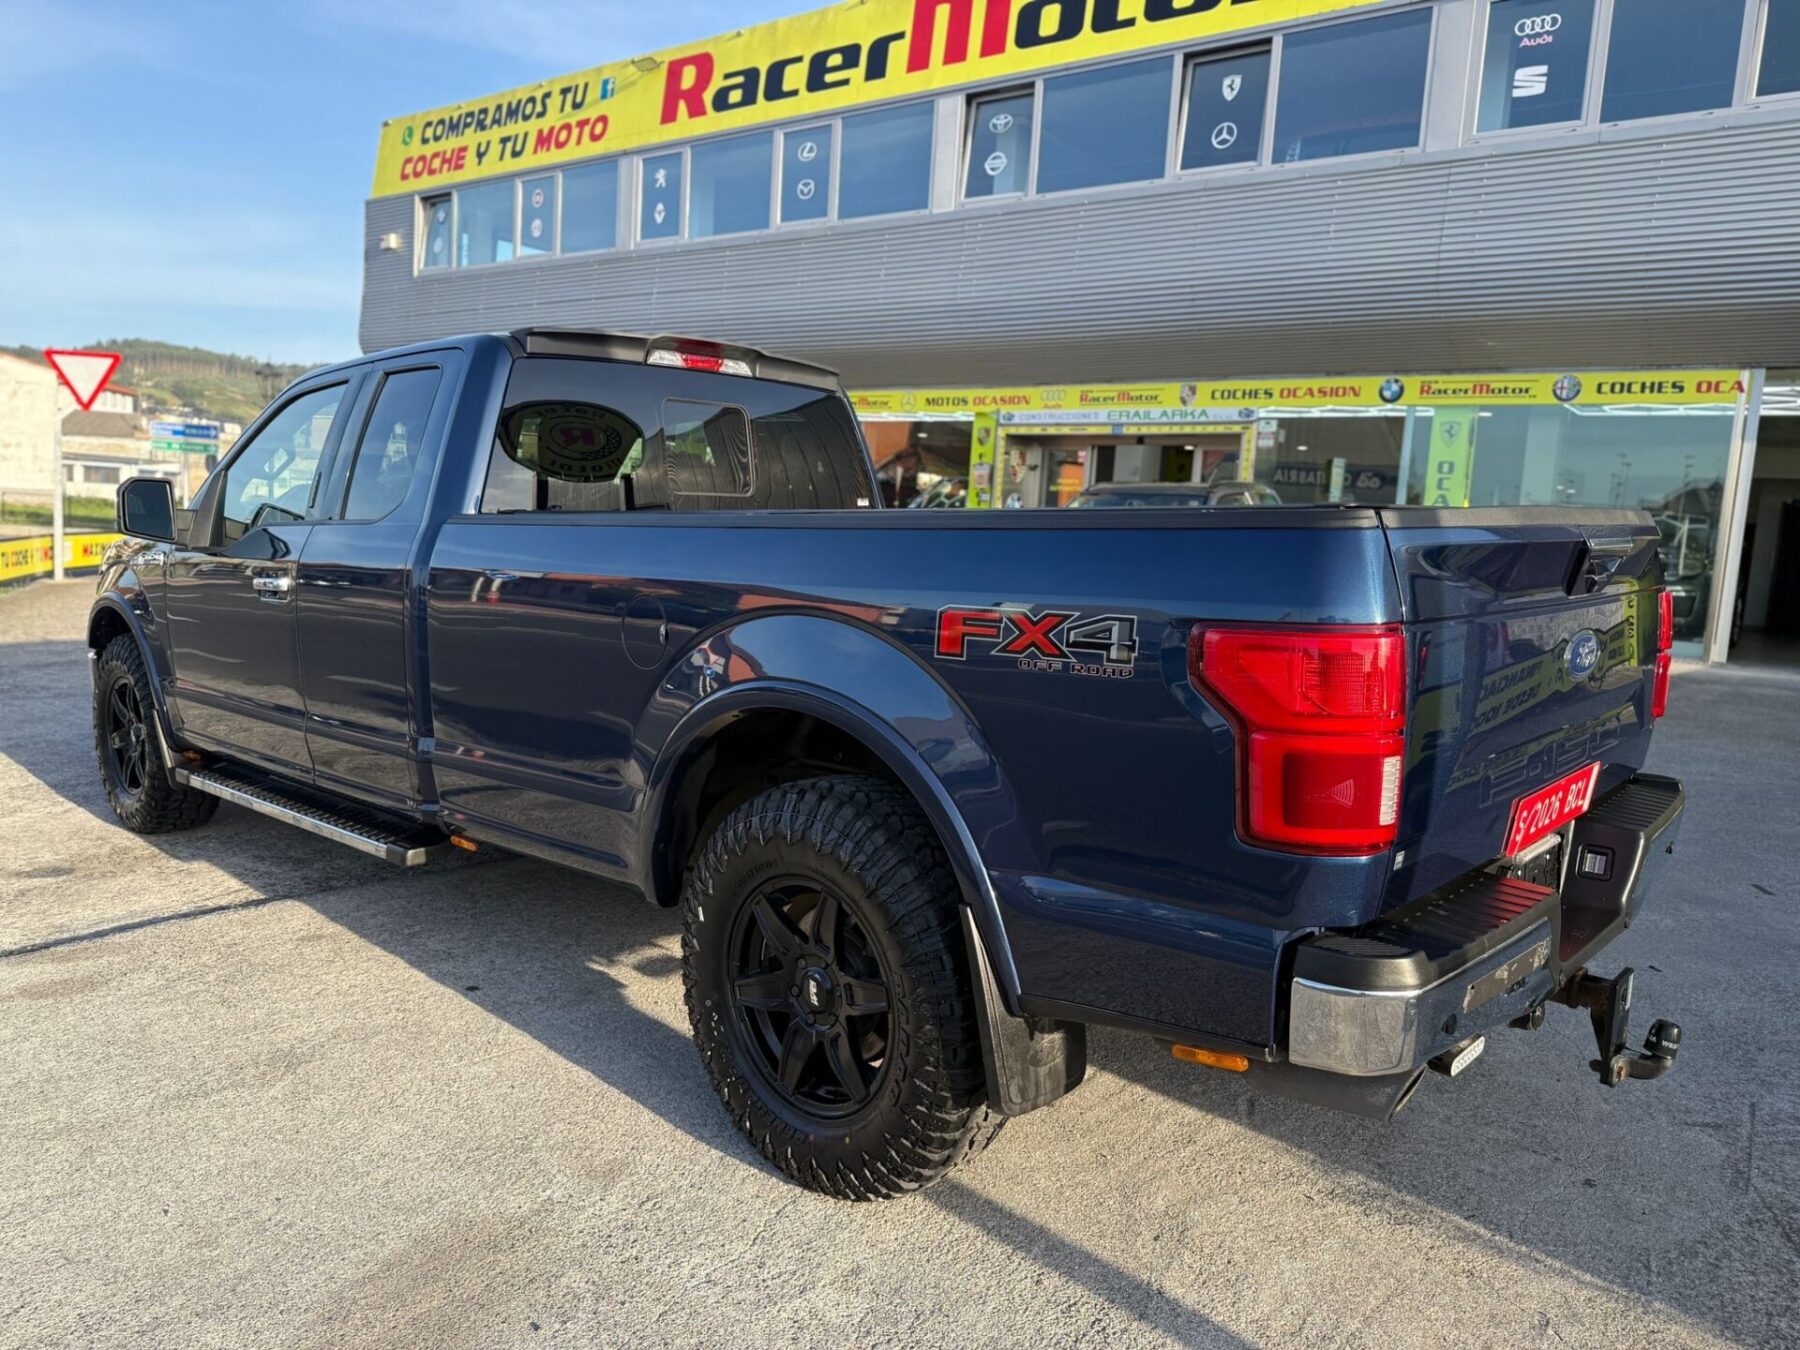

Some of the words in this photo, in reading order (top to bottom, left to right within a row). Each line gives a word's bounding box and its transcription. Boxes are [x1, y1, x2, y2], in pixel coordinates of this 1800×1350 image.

[1519, 34, 1553, 48] Audi
[659, 0, 1264, 126] RacerMot
[420, 91, 552, 145] COMPRAMOS
[559, 82, 589, 113] TU
[400, 145, 468, 181] COCHE
[475, 140, 491, 166] Y
[499, 131, 529, 162] TU
[532, 114, 609, 154] MOTO
[1211, 387, 1274, 400] COCHES
[1279, 385, 1362, 399] OCASION
[1418, 383, 1533, 396] RacerMotor
[1596, 380, 1685, 395] COCHES
[1695, 380, 1746, 394] OCA
[925, 395, 969, 407] MOTOS
[973, 393, 1032, 407] OCASION
[1079, 390, 1160, 404] RacerMotor
[1106, 408, 1210, 421] ERAILARKA
[934, 604, 1139, 667] FX4
[1017, 658, 1063, 672] OFF
[1070, 663, 1134, 679] ROAD
[1564, 778, 1587, 814] BCL
